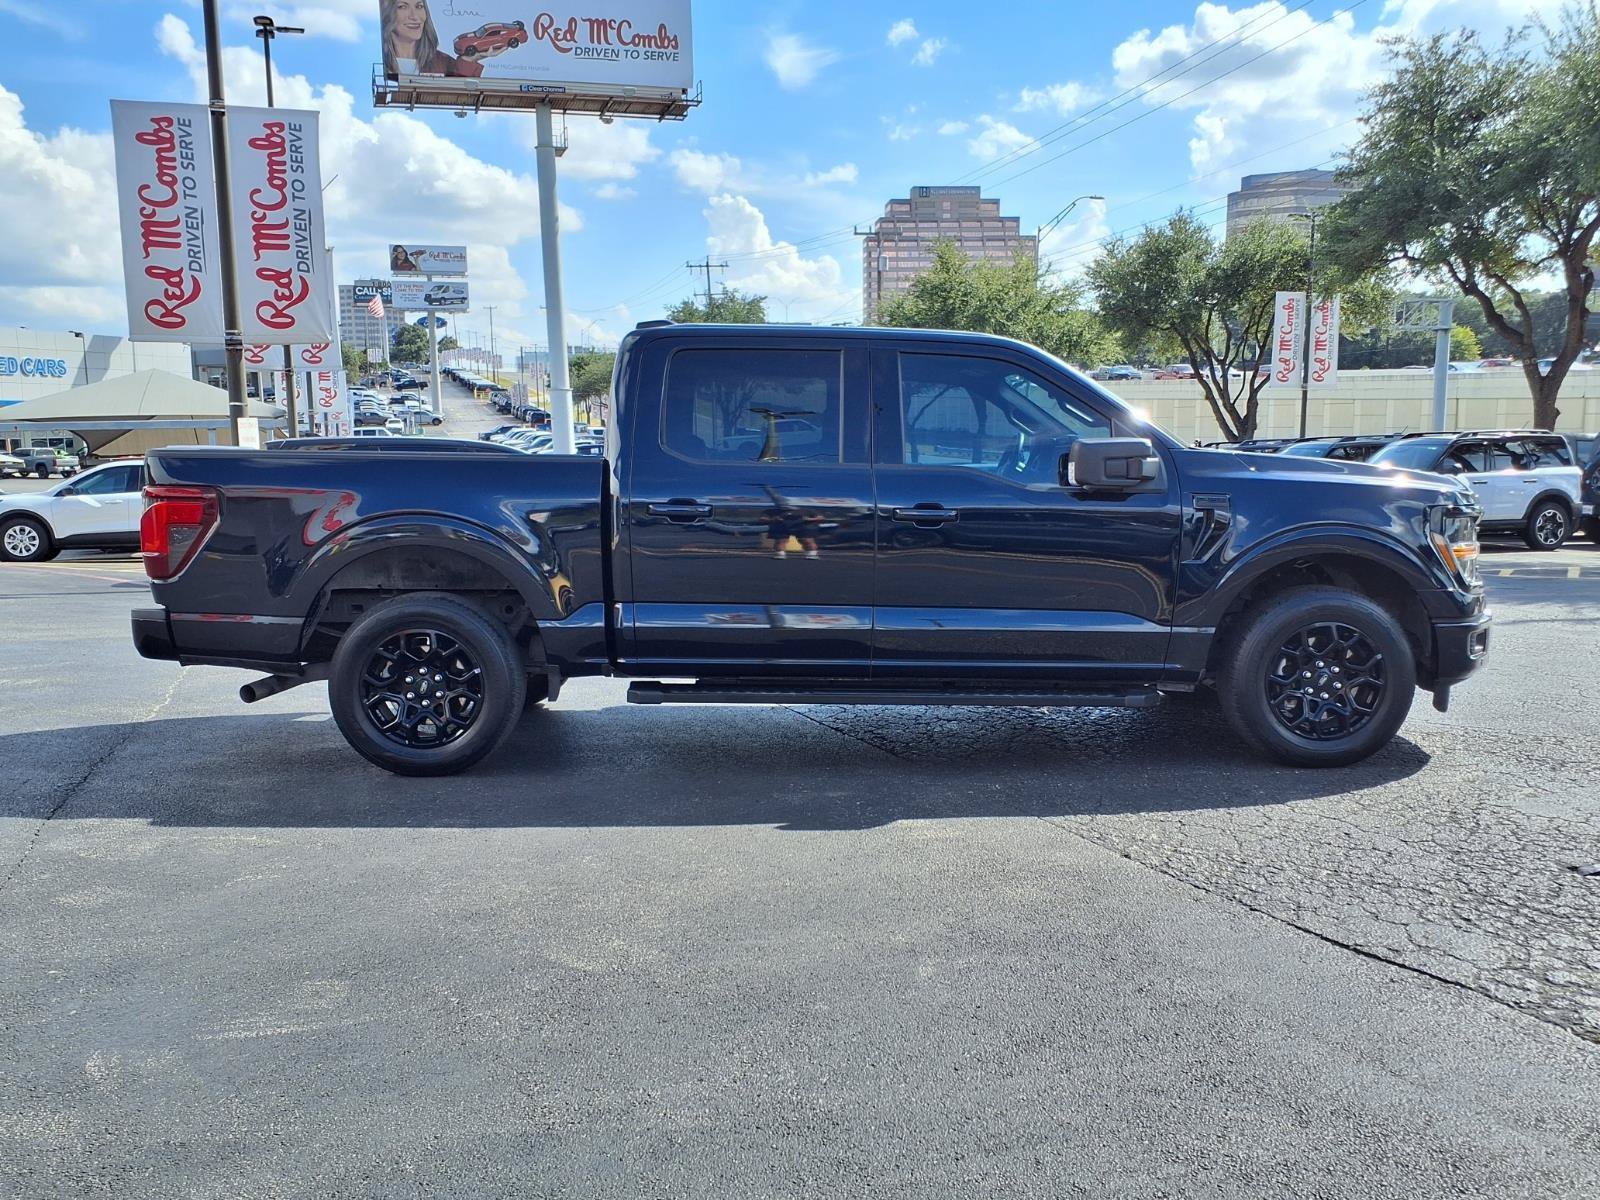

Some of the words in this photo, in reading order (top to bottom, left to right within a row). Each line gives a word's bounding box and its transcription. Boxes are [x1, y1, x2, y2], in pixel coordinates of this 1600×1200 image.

[533, 12, 578, 54] Red
[581, 17, 679, 50] McCombs
[574, 47, 619, 58] DRIVEN
[624, 50, 640, 60] TO
[643, 51, 679, 62] SERVE
[177, 117, 195, 172] SERVE
[288, 122, 303, 174] SERVE
[135, 116, 182, 259] McCombs
[182, 176, 197, 200] TO
[248, 121, 291, 261] McCombs
[291, 179, 306, 203] TO
[183, 206, 202, 273] DRIVEN
[292, 208, 309, 274] DRIVEN
[144, 265, 201, 329] Red
[256, 267, 309, 330] Red
[1279, 298, 1295, 355] McCombs
[21, 357, 67, 376] CARS
[1276, 357, 1296, 382] Red
[1312, 357, 1331, 382] Red
[319, 386, 338, 408] Red
